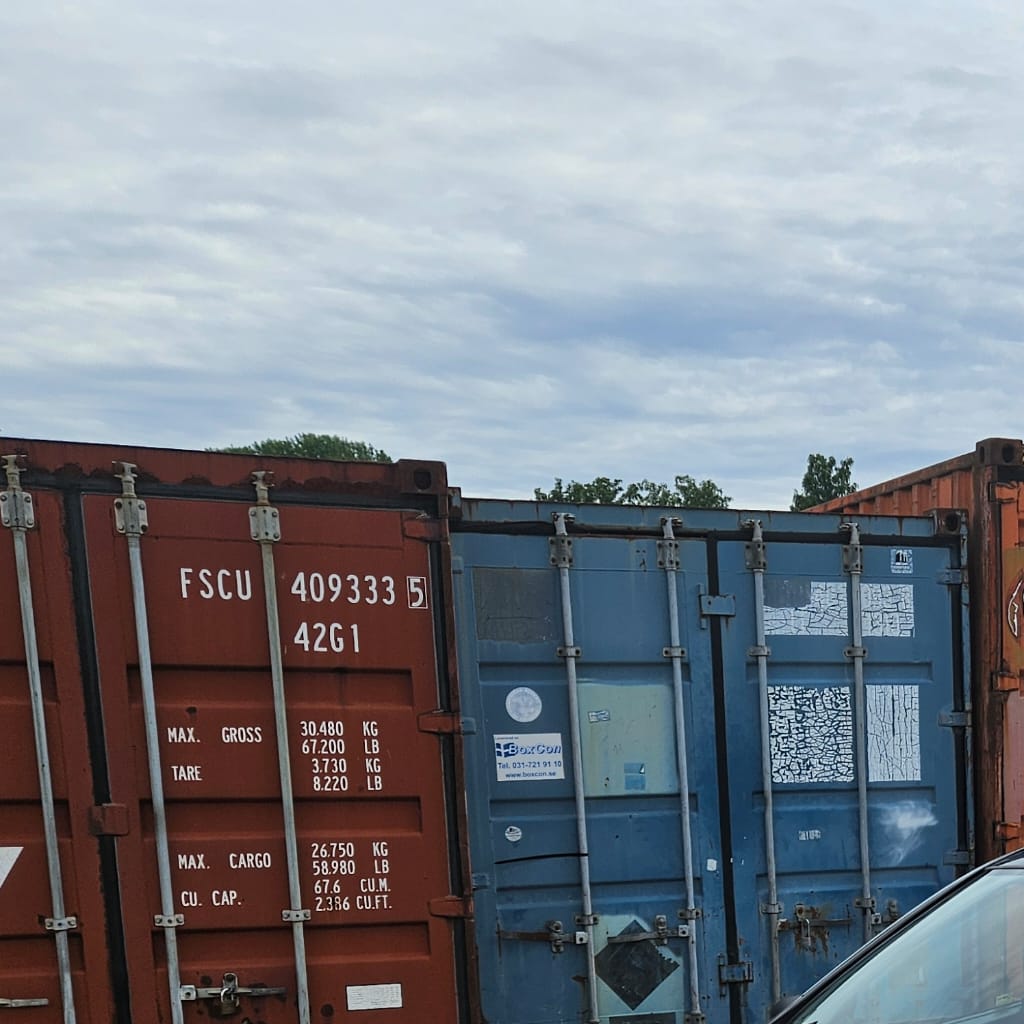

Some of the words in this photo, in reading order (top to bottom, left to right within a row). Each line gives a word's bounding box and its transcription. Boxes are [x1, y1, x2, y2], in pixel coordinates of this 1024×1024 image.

[179, 567, 252, 601] FSCU
[290, 571, 396, 606] 409333
[408, 577, 425, 607] 5
[293, 621, 360, 653] 42G1
[167, 727, 201, 743] MAX.
[221, 727, 263, 743] GROSS
[299, 721, 344, 736] 30.480
[363, 721, 378, 736] KG
[302, 739, 345, 755] 67.200
[364, 739, 380, 754] LB
[508, 743, 562, 755] BoxCon
[171, 765, 202, 781] TARE
[311, 758, 347, 774] 3.730
[365, 758, 381, 773] KG
[512, 761, 540, 769] 031-721
[554, 760, 562, 768] 10
[313, 775, 348, 791] 8.220
[366, 775, 383, 791] LB
[311, 842, 354, 858] 26.750
[373, 841, 388, 857] KG
[178, 854, 211, 870] MAX.
[229, 852, 272, 869] CARGO
[312, 860, 356, 876] 58.980
[374, 859, 390, 874] LB
[314, 879, 341, 895] 67.6
[360, 878, 392, 893] CU.M.
[181, 890, 203, 907] CU.
[212, 890, 242, 906] CAP.
[315, 896, 350, 912] 2.386
[356, 894, 393, 910] CU.FT.
